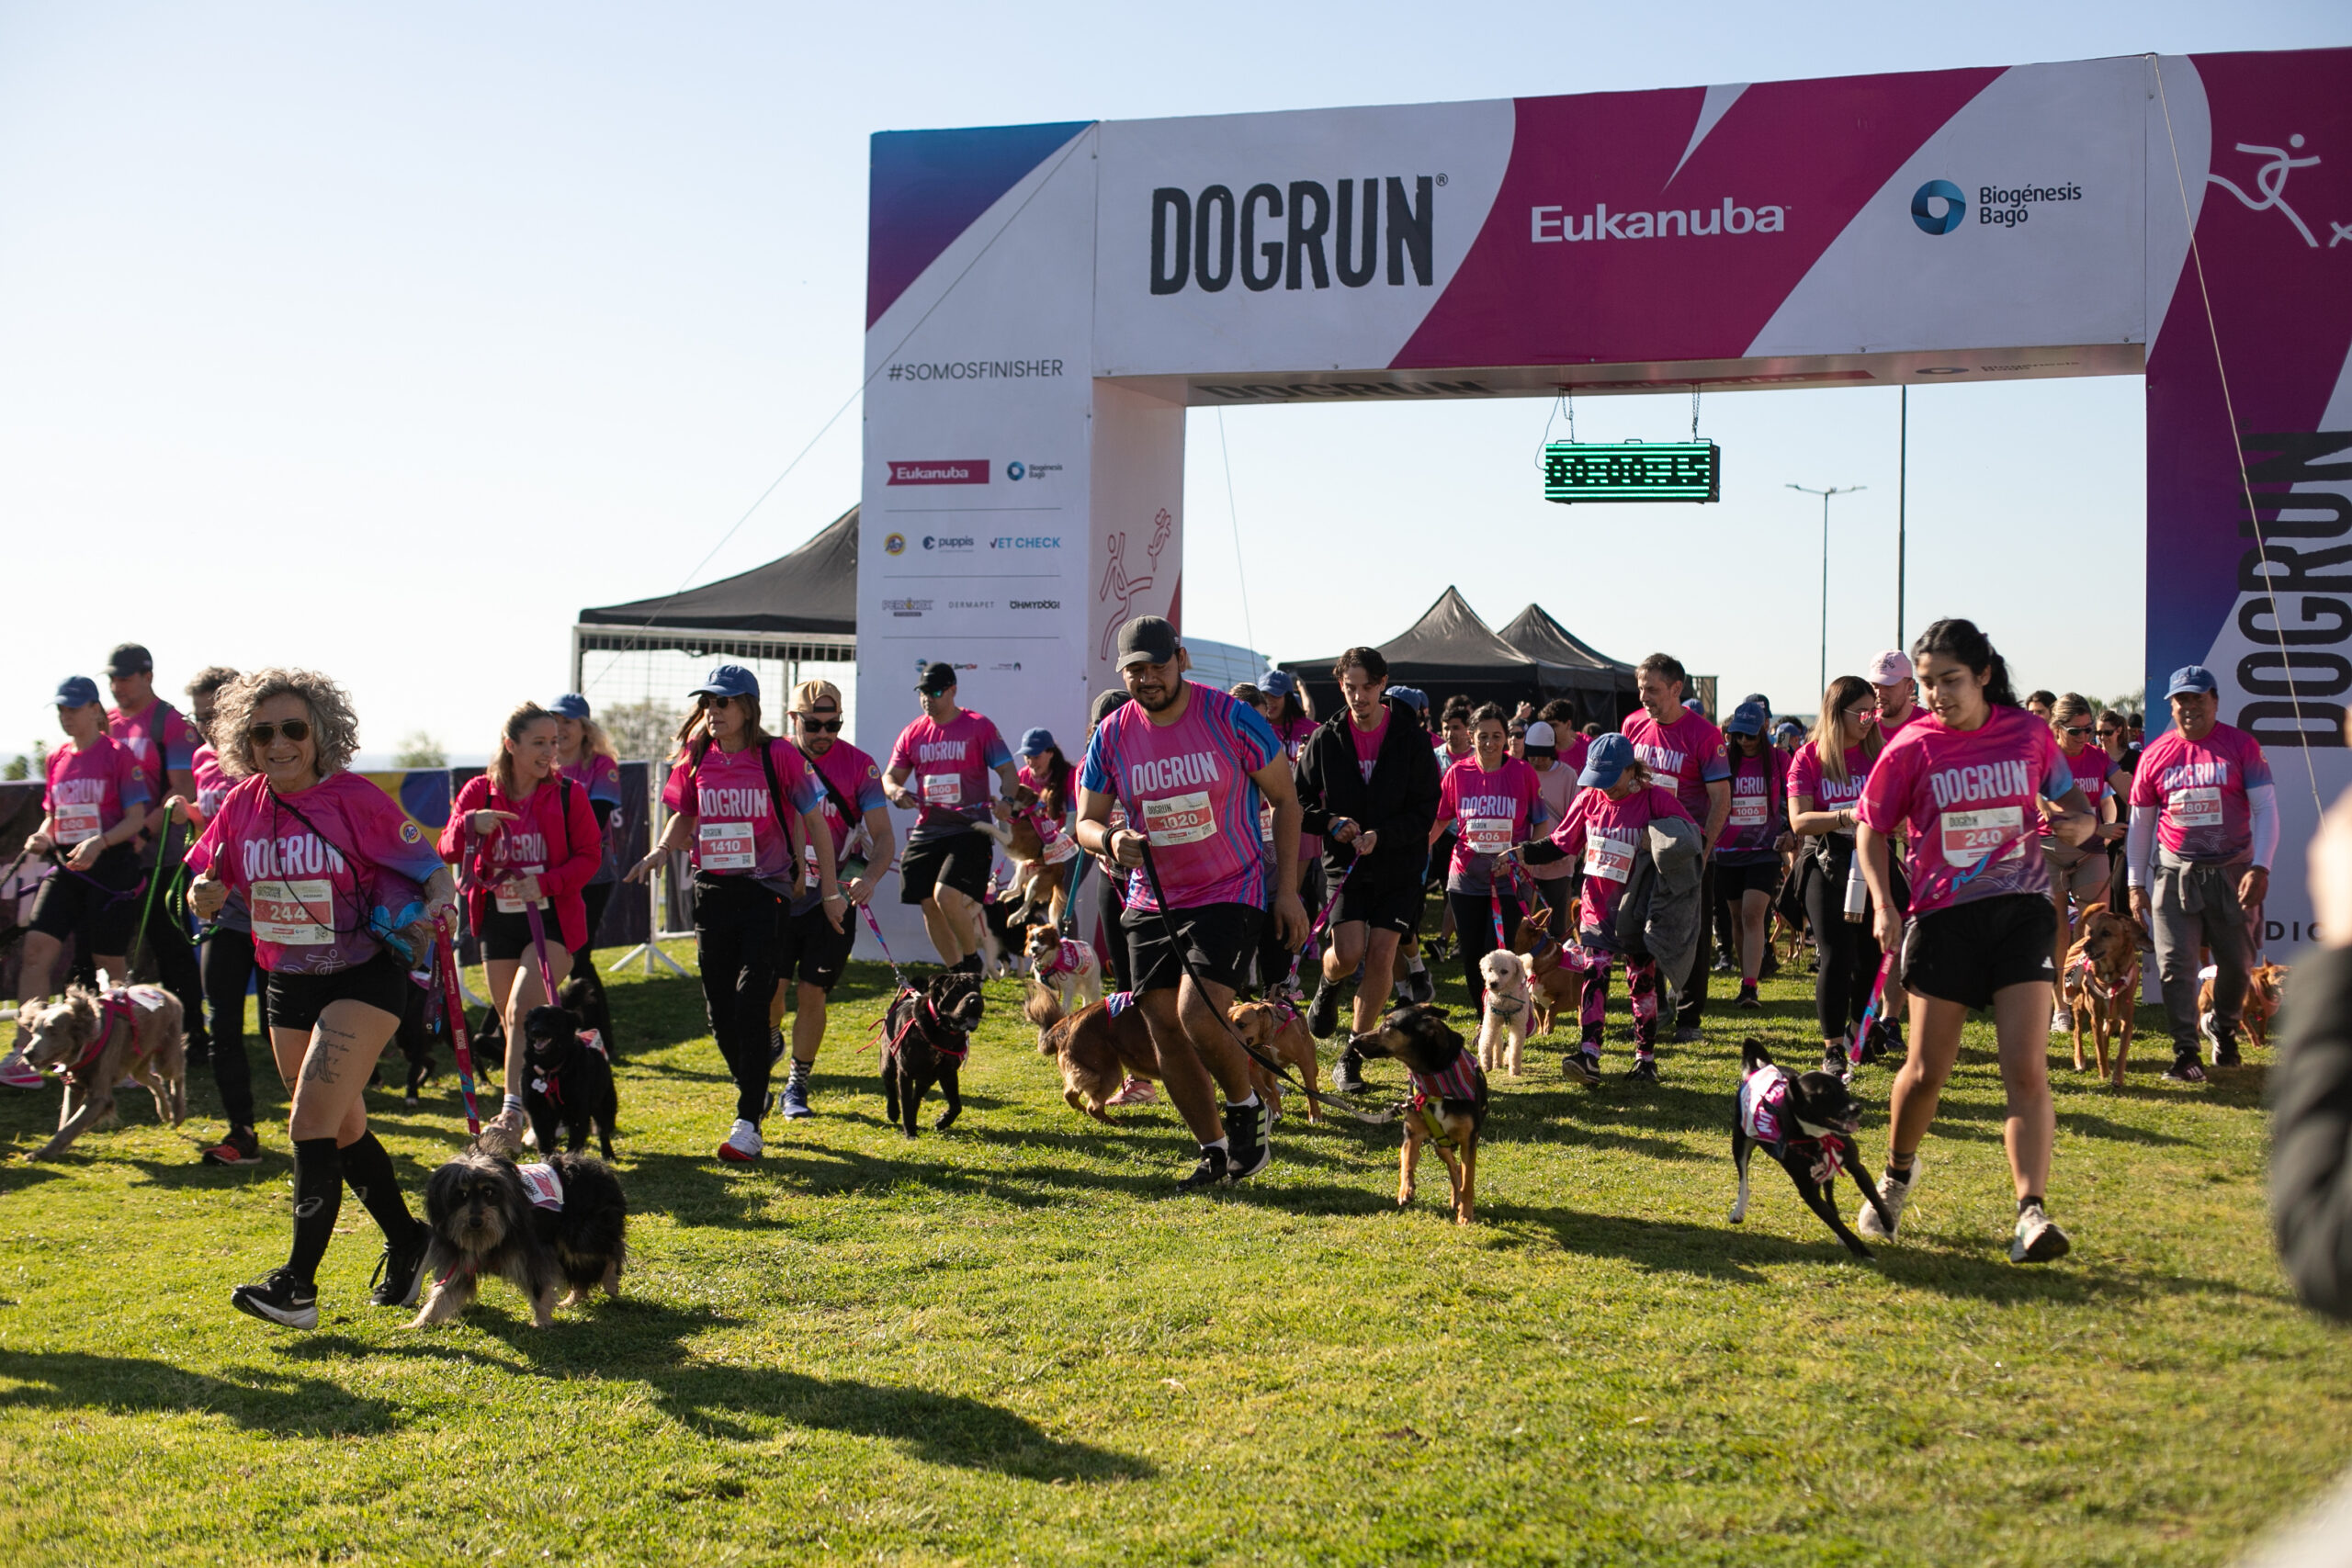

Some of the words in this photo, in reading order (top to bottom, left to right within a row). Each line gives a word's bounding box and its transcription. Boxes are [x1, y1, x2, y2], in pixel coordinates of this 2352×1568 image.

[1979, 182, 2082, 208] Biogénesis
[1532, 197, 1785, 243] Eukanuba
[1979, 205, 2029, 228] Bagó
[1150, 175, 1433, 295] DOGRUN
[888, 359, 1063, 382] #SOMOSFINISHER
[897, 467, 968, 480] Eukanuba
[938, 536, 974, 548] puppis
[1015, 537, 1061, 549] CHECK
[2237, 432, 2352, 747] DOGRUN
[948, 601, 995, 609] DERMAPET
[1132, 751, 1219, 795] DOGRUN
[1931, 760, 2029, 809] DOGRUN
[2164, 762, 2227, 790] DOGRUN
[699, 788, 767, 818] DOGRUN
[1461, 795, 1517, 819] DOGRUN
[1736, 807, 1759, 816] 1006
[710, 840, 741, 852] 1410
[1478, 832, 1499, 841] 606
[1965, 829, 2002, 847] 240
[243, 833, 345, 882] DOGRUN
[270, 905, 308, 921] 244
